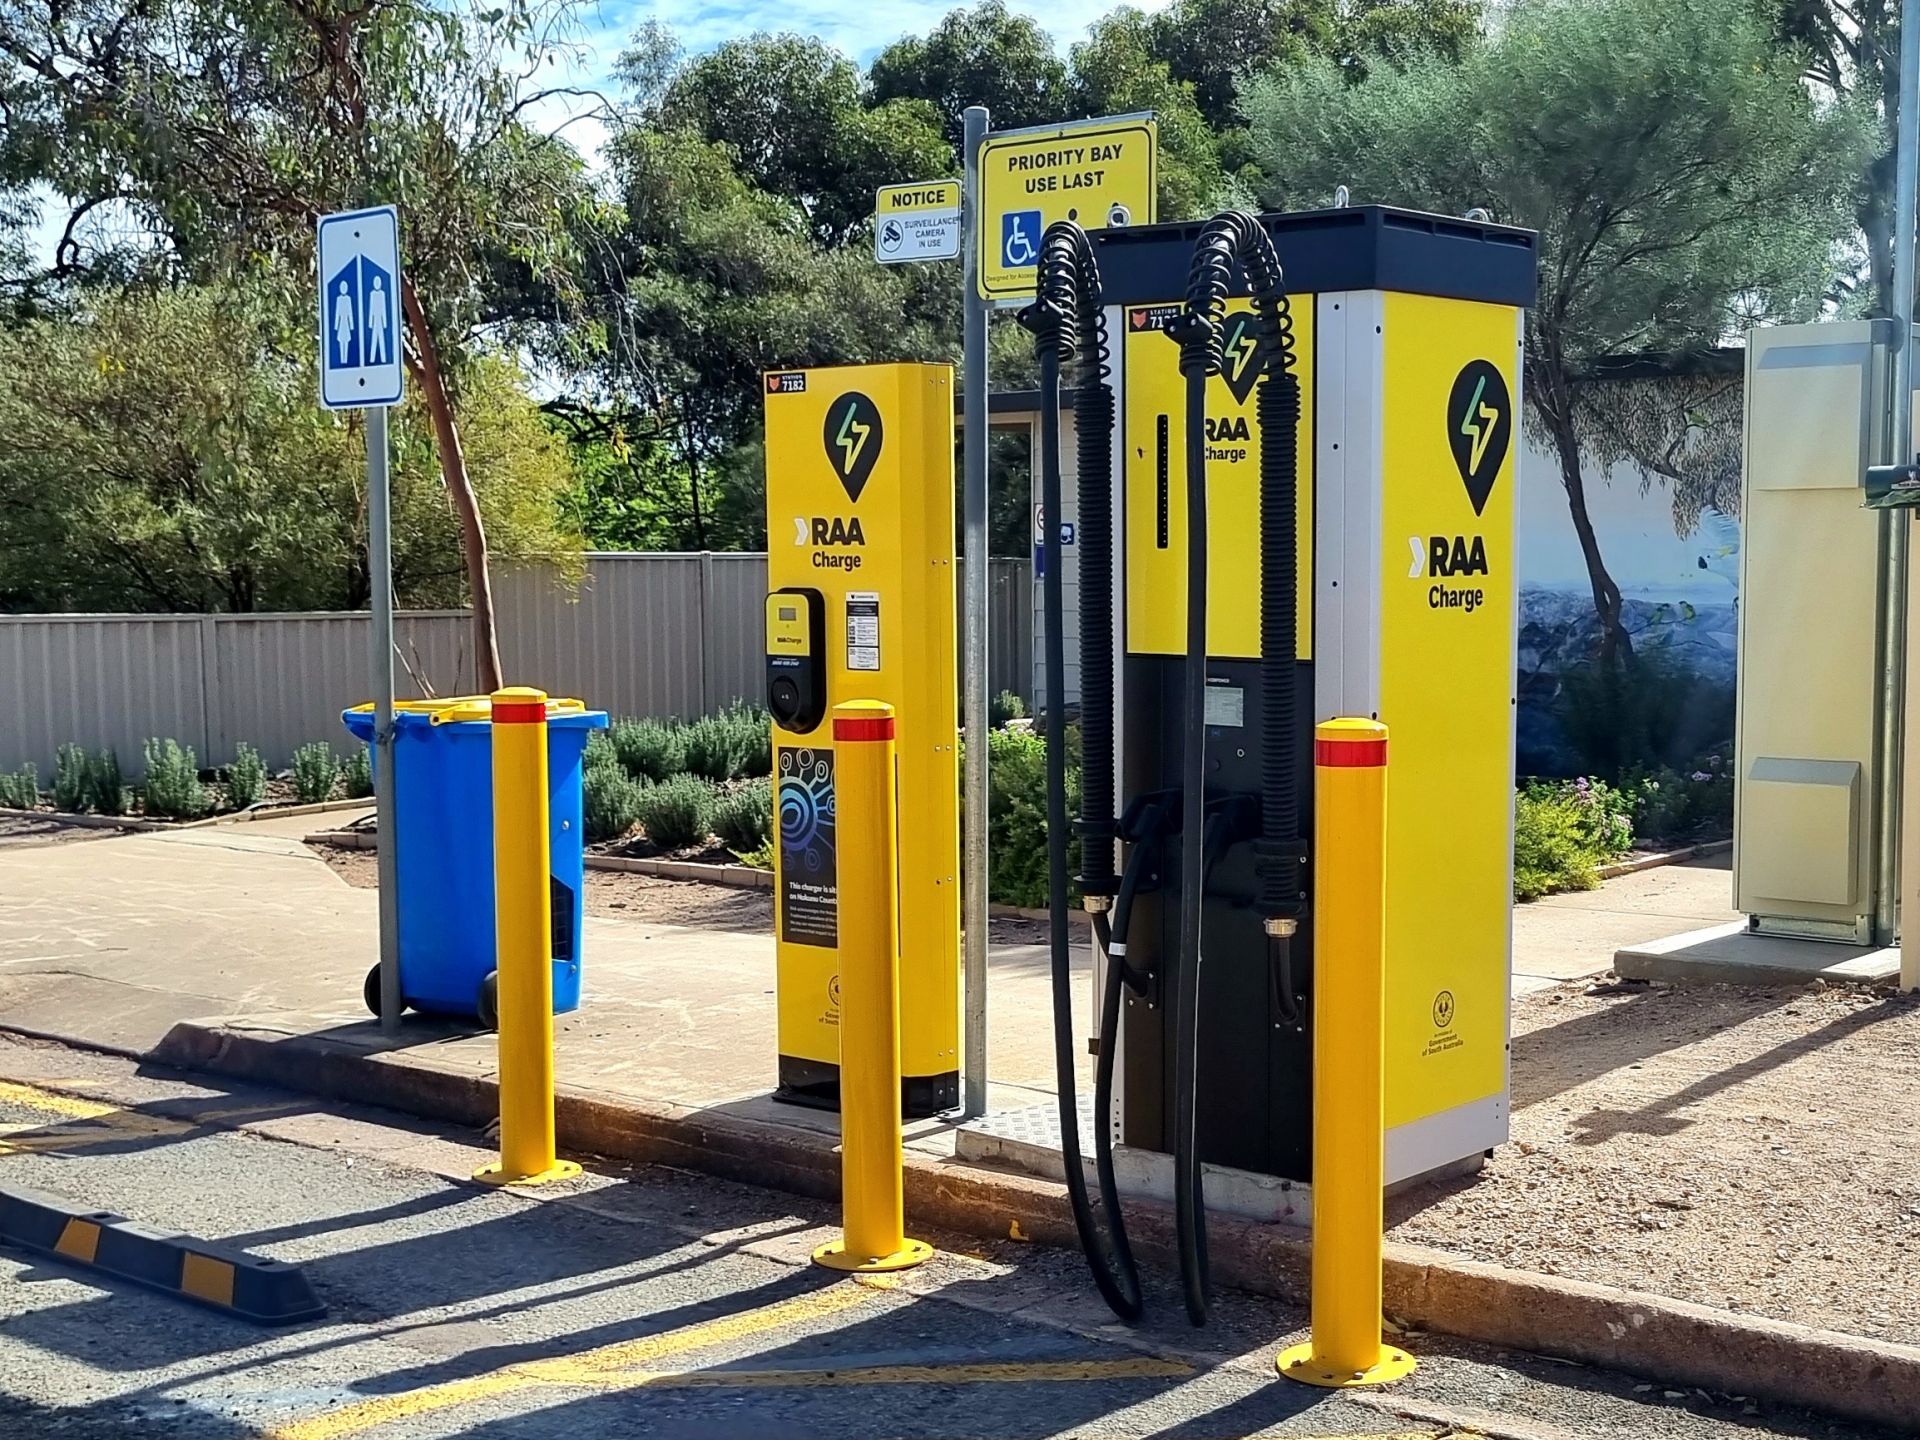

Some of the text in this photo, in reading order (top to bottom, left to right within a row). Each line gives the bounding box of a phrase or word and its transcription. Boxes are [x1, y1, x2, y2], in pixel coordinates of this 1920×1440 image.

[1008, 143, 1123, 172] PRIORITY BAY
[1025, 170, 1105, 193] USE LAST
[892, 190, 945, 207] NOTICE
[904, 216, 958, 229] SURVEILLANCE
[915, 229, 945, 238] CAMERA
[919, 239, 941, 248] IN USE
[782, 380, 804, 391] 7182
[1205, 417, 1250, 442] RAA
[1205, 446, 1246, 463] harge
[812, 517, 865, 546] RAA
[812, 551, 861, 572] Charge
[1429, 536, 1488, 577] RAA
[1429, 584, 1483, 612] Charge
[789, 881, 801, 890] This
